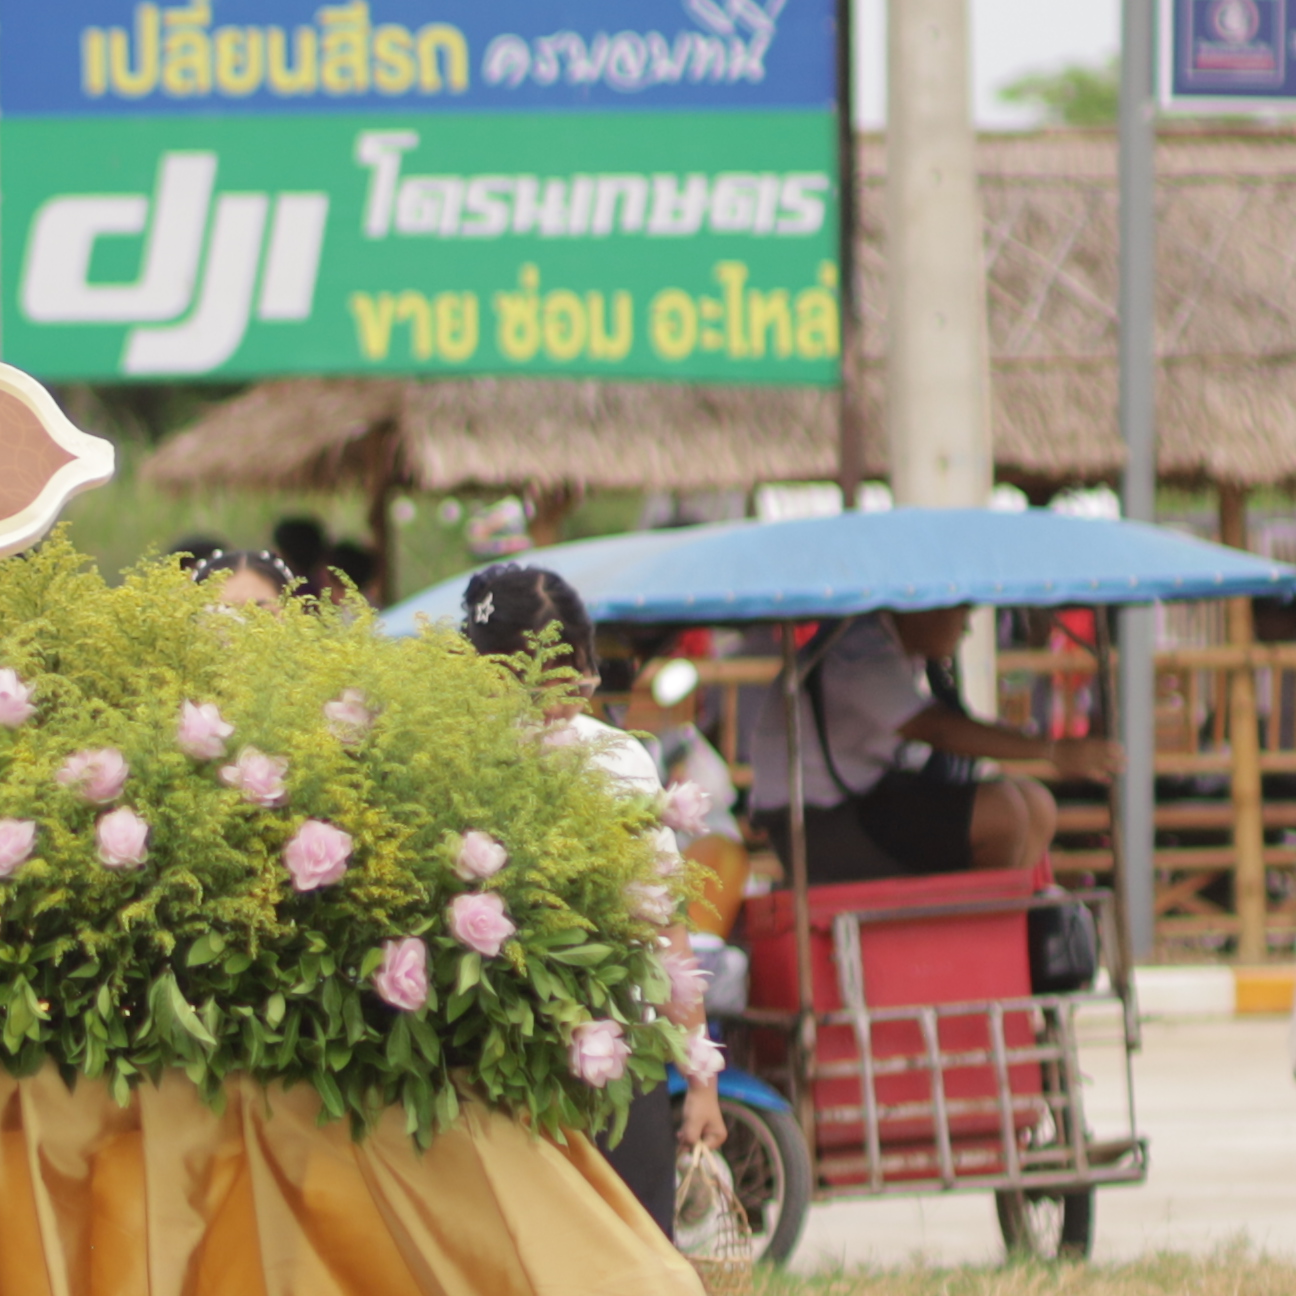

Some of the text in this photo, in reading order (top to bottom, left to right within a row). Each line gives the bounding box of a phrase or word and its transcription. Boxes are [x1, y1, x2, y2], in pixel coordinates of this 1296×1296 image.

[356, 128, 830, 240] โดรนเกษตร
[352, 258, 842, 362] ขาย ซ่อม อะไหล่
